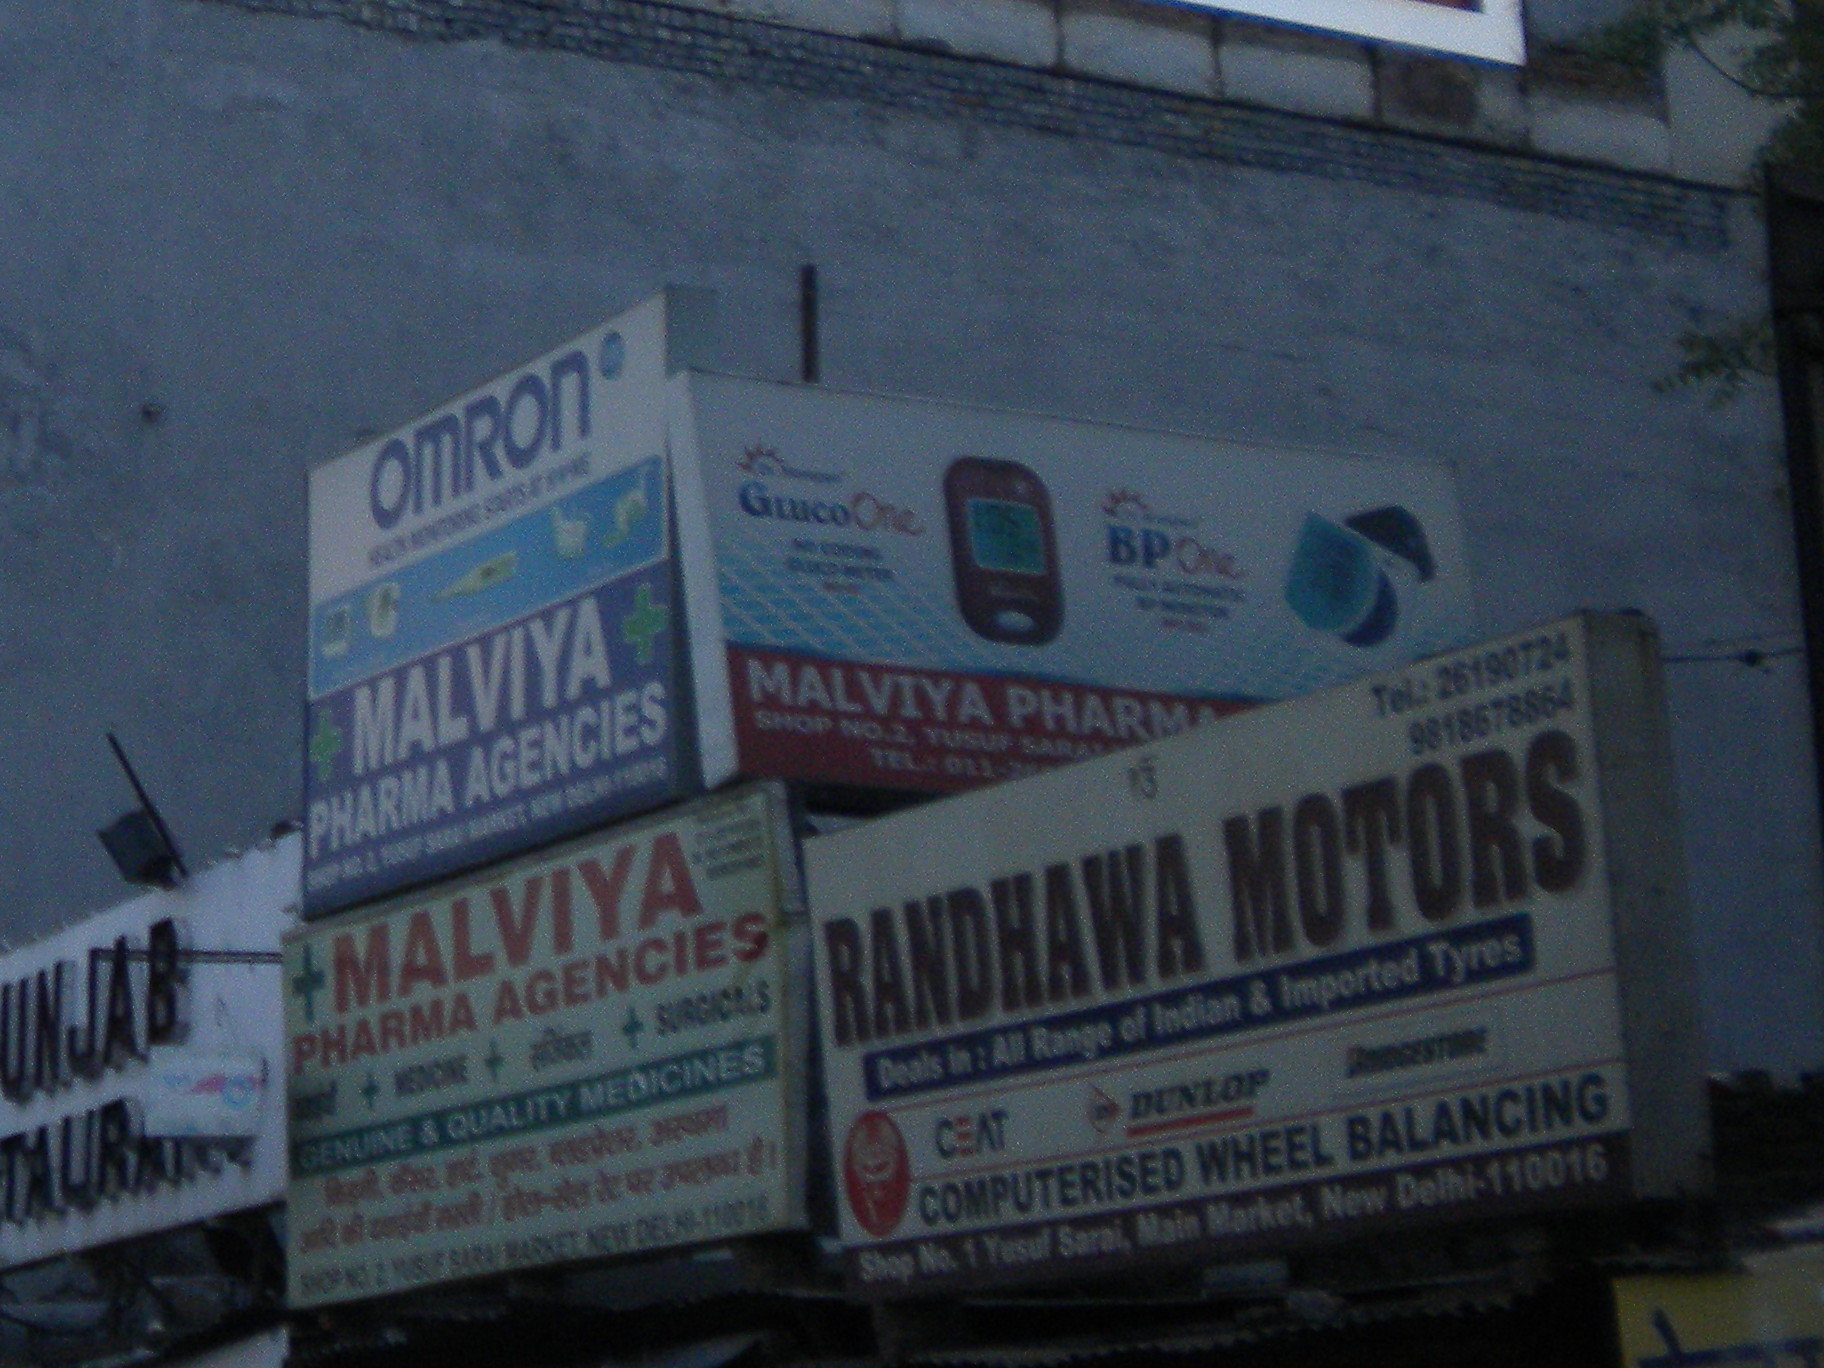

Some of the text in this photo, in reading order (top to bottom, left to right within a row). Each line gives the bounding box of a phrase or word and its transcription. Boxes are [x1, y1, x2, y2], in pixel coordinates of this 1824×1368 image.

[353, 596, 611, 776] MALVIYA
[746, 657, 995, 725] MALVIYA
[309, 758, 456, 858] PHARMA
[466, 682, 667, 808] AGENCIES
[333, 832, 703, 1015] MALVIYA
[823, 729, 1587, 1046] RANDHAWA MOTORS
[292, 994, 475, 1076] PHARMA
[493, 913, 769, 1025] AGENCIES
[879, 1048, 943, 1090] Deals
[1031, 1022, 1112, 1059] Range
[1151, 992, 1240, 1036] Indian
[1248, 980, 1272, 1013] &
[1280, 950, 1420, 1012] Imported
[1430, 934, 1521, 982] Tyres
[300, 1132, 409, 1172] GENUINE
[417, 1120, 439, 1149] &
[447, 1093, 570, 1134] QUALITY
[579, 1044, 765, 1112] MEDICINES
[918, 1073, 1608, 1225] COMPUTERISED WHEEL BALANCING
[935, 1109, 1007, 1159] CEAT
[1130, 1069, 1269, 1119] DUNLOP
[1320, 1181, 1387, 1220] New
